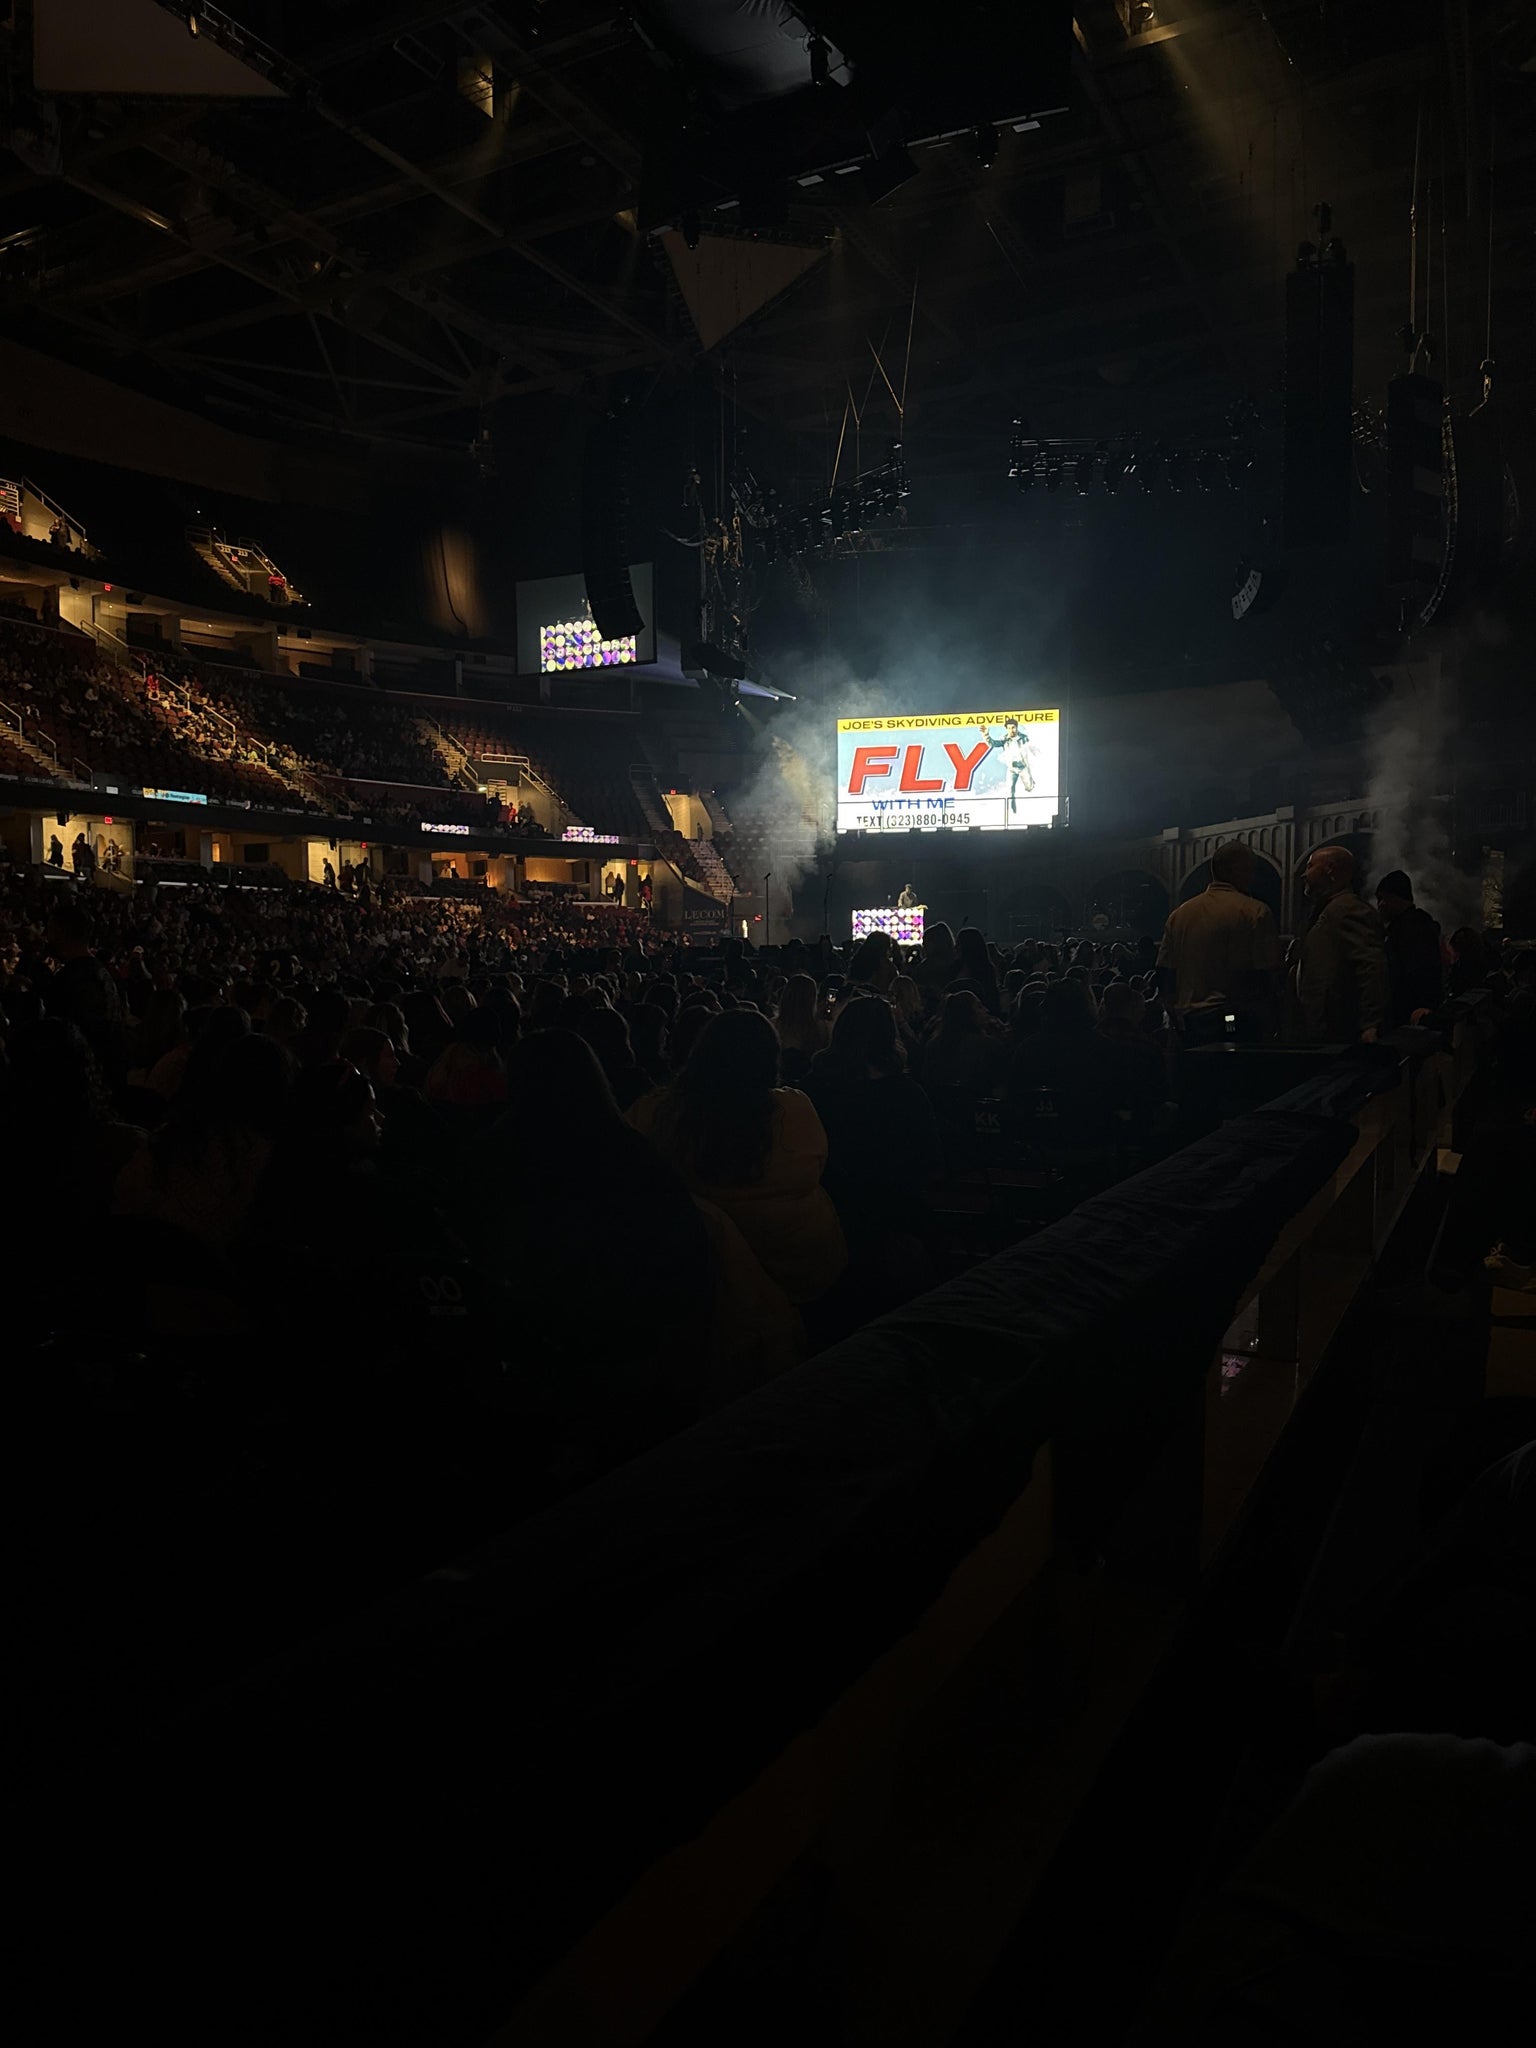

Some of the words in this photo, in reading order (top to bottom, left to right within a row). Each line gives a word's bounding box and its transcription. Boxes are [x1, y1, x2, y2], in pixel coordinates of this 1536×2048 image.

[842, 720, 883, 730] JOE'S
[887, 716, 962, 728] SKYDIVING
[966, 712, 1054, 725] ADVENTURE
[847, 741, 992, 795] FLY
[872, 798, 921, 811] WITH
[927, 797, 956, 809] ME
[856, 816, 882, 827] TEXT
[886, 813, 970, 828] (323)880-0945
[684, 909, 725, 919] LECOM
[976, 1112, 1001, 1128] KK
